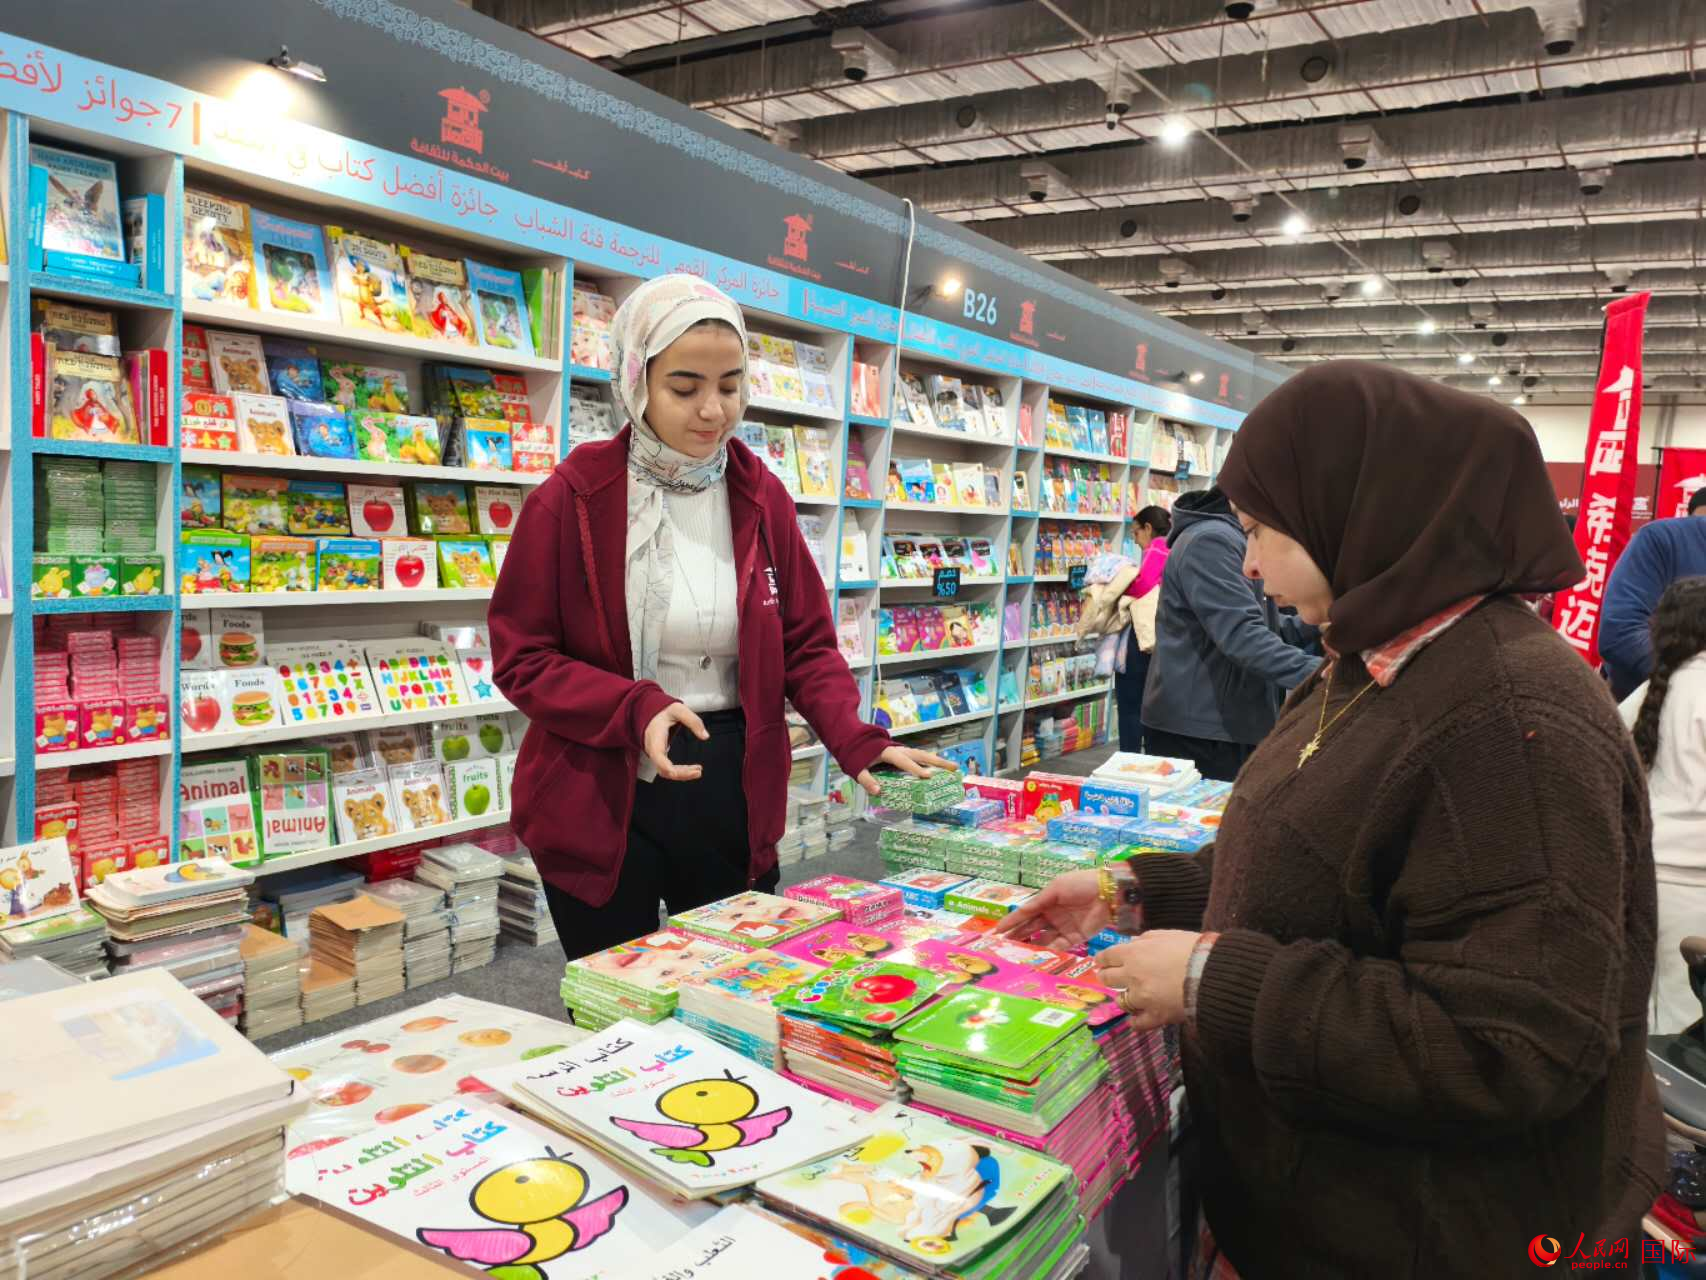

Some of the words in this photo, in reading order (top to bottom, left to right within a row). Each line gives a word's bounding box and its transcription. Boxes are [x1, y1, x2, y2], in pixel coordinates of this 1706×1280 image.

[383, 169, 444, 202] أفضل
[450, 184, 498, 224] جائزة
[514, 208, 573, 241] الشباب
[964, 288, 997, 326] B26
[223, 619, 251, 629] Foods
[234, 679, 264, 688] Foods
[440, 721, 469, 731] fruits
[346, 785, 376, 796] Animals
[463, 770, 489, 784] fruits
[266, 815, 326, 838] Animal
[957, 901, 989, 914] Animals
[584, 1037, 635, 1063] كتاب
[639, 1044, 695, 1072] كتاب
[556, 1066, 637, 1097] التلوين
[446, 1121, 508, 1157] كتاب
[348, 1152, 444, 1206] التلوين
[695, 1235, 737, 1267] الثعلب
